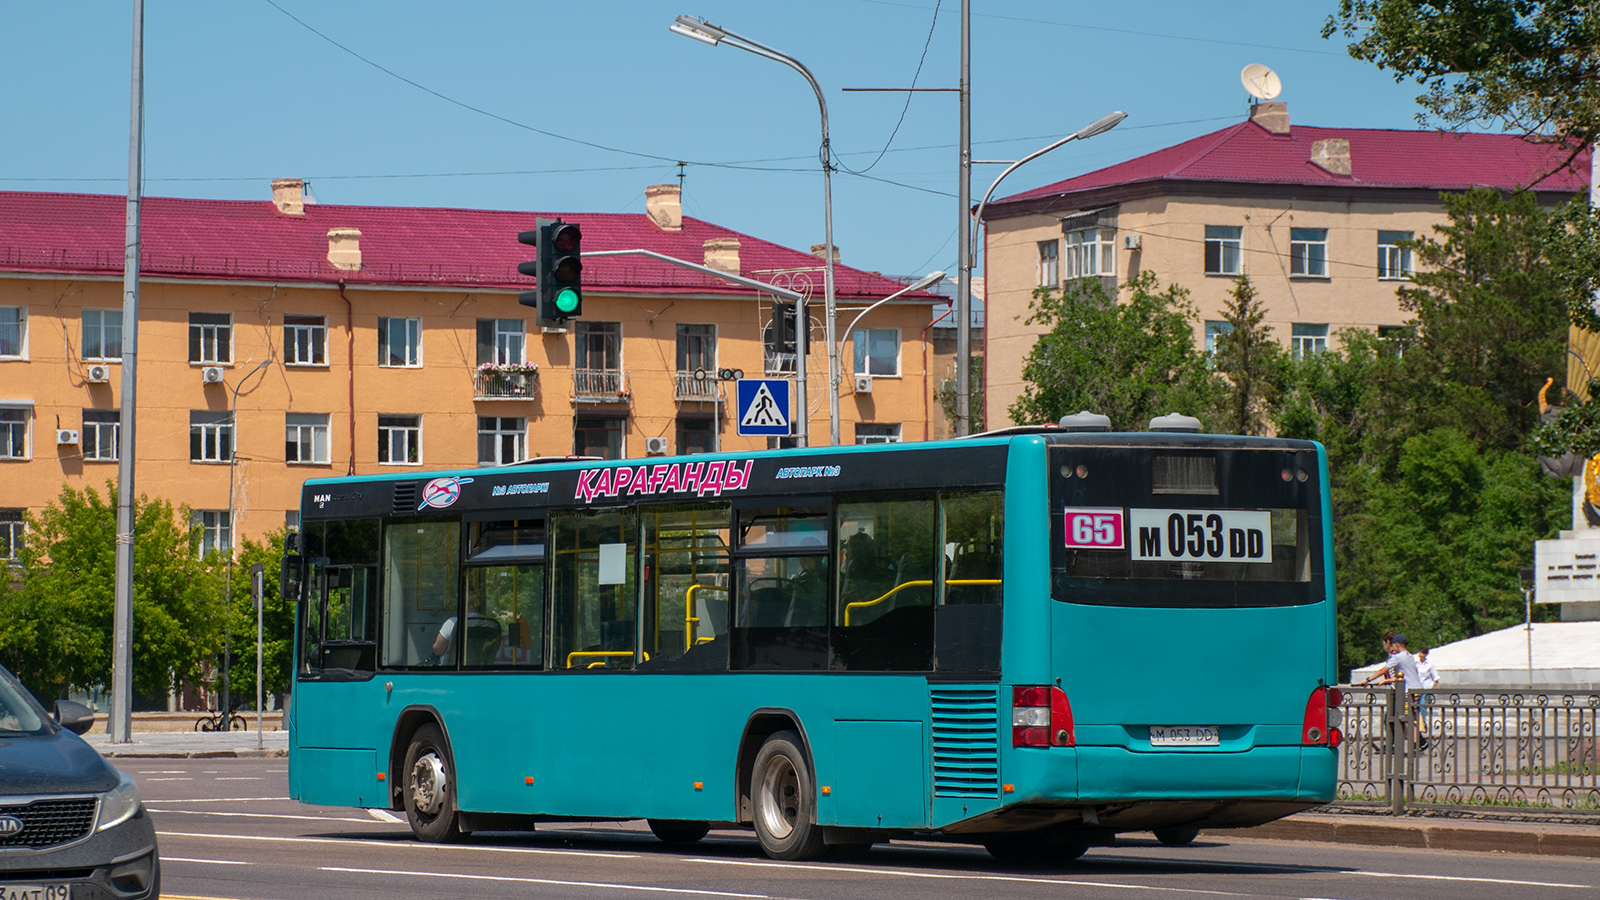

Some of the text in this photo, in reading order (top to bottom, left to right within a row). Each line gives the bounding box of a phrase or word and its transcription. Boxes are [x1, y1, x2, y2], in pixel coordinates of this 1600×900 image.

[775, 465, 841, 479] АВТОПАРК №3
[574, 459, 754, 504] ҚАРАҒАНДЫ
[492, 485, 507, 496] №3
[313, 494, 332, 503] MAN
[1072, 515, 1115, 544] 65
[1139, 513, 1264, 558] M 053 DD
[1156, 728, 1213, 742] M 053 DD
[0, 819, 18, 832] IA
